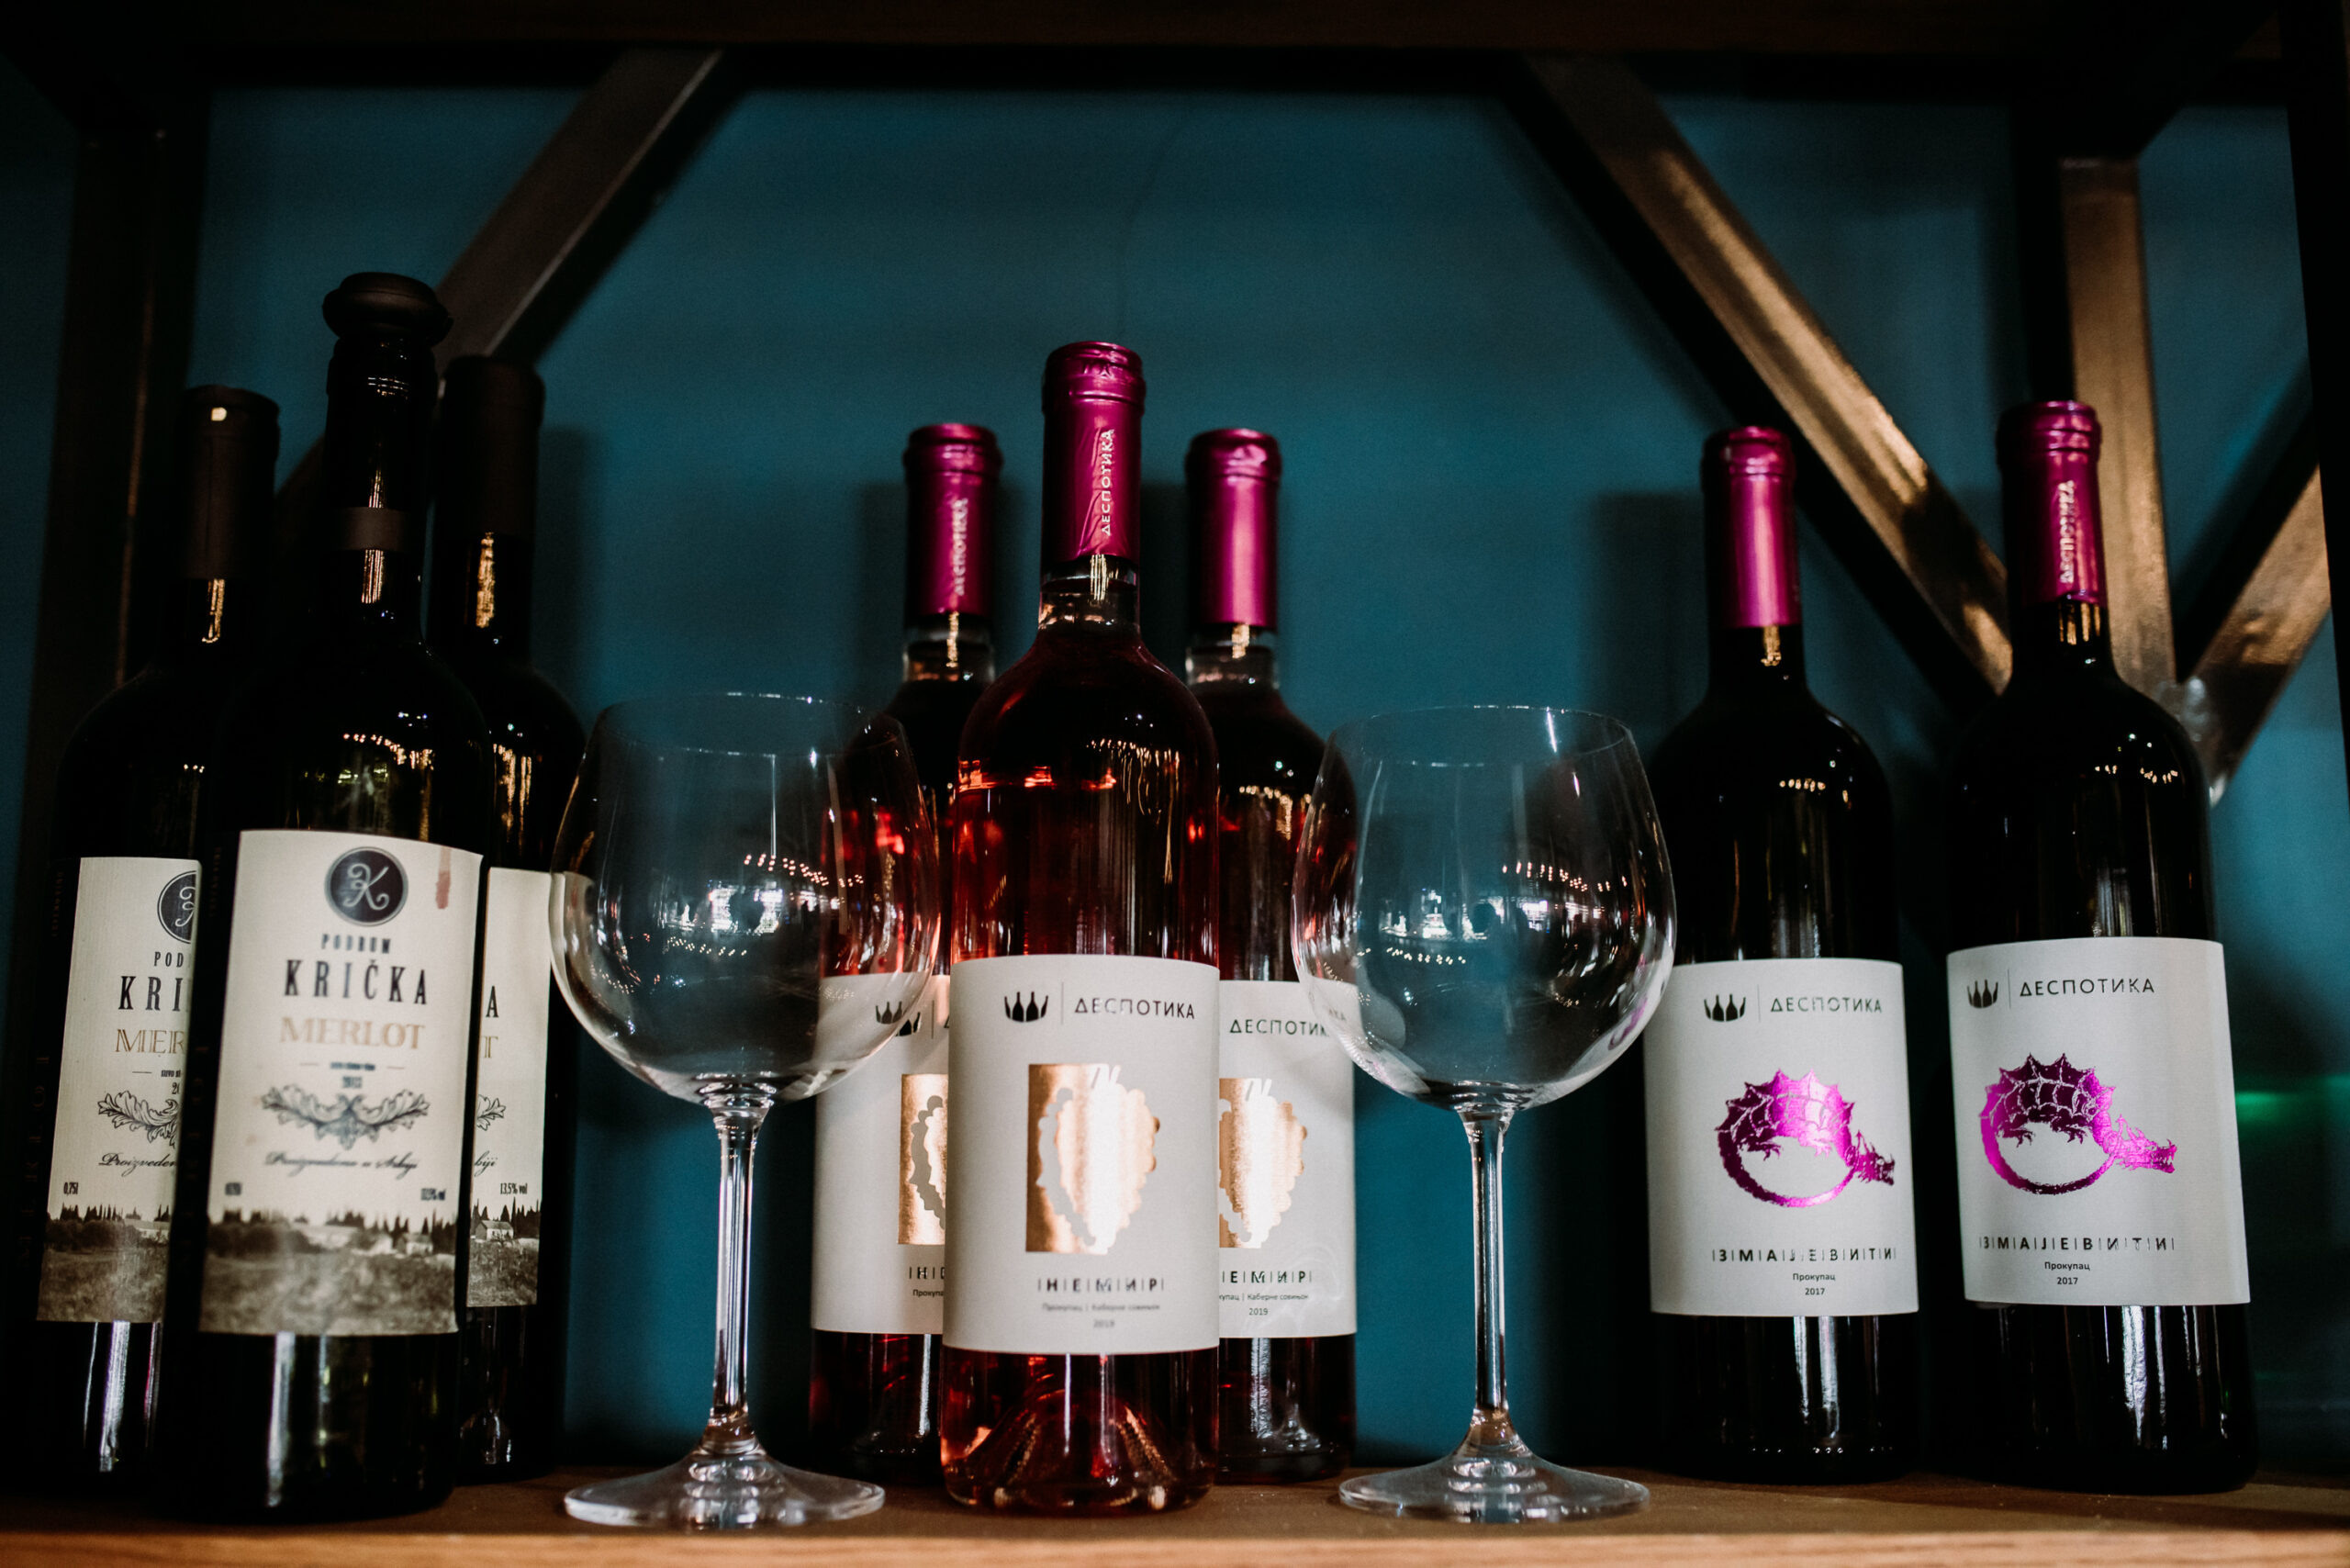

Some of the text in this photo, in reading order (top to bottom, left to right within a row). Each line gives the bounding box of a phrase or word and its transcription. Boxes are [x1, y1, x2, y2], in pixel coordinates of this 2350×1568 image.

[1101, 429, 1114, 537] ДЕСПОТИКА
[284, 959, 428, 1005] KRIČKA
[2020, 978, 2154, 997] ДЕСПОТИКА
[1074, 997, 1195, 1020] ДЕСПОТИКА
[1770, 996, 1883, 1014] ДЕСПОТИКА
[279, 1016, 427, 1049] MERLOT
[2044, 1261, 2090, 1271] Прокупац
[1792, 1272, 1836, 1282] Прокупац
[2056, 1277, 2078, 1285] 2017
[1805, 1287, 1825, 1295] 2017
[1248, 1307, 1269, 1316] 2019
